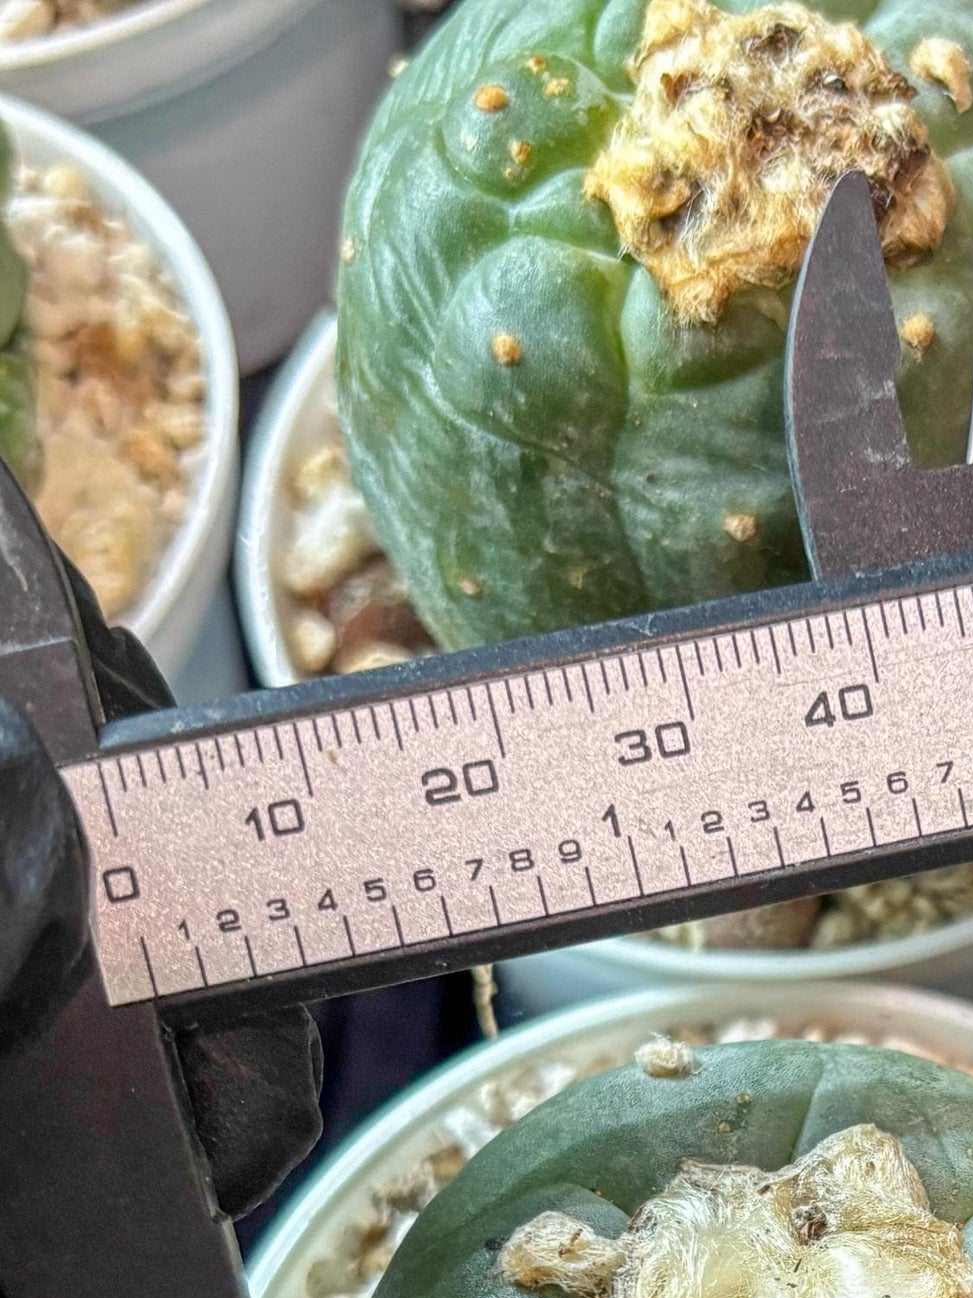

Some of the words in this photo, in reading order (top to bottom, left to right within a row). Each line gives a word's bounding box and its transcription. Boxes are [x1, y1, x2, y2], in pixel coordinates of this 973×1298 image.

[103, 866, 140, 904] 0
[245, 798, 305, 841] 10
[421, 759, 499, 806] 20
[614, 721, 691, 766] 30
[804, 683, 873, 727] 40
[178, 919, 190, 940] 1
[216, 909, 241, 933] 2
[266, 898, 290, 921] 3
[317, 888, 338, 911] 4
[363, 878, 387, 902] 5
[413, 868, 436, 892] 6
[465, 858, 484, 881] 7
[509, 848, 535, 873] 8
[558, 839, 582, 864] 9
[601, 804, 621, 838] 1
[664, 820, 675, 841] 1
[701, 811, 724, 834] 2
[748, 800, 770, 823] 3
[796, 791, 815, 812] 4
[840, 780, 861, 804] 5
[887, 771, 908, 794] 6
[936, 761, 954, 783] 7
